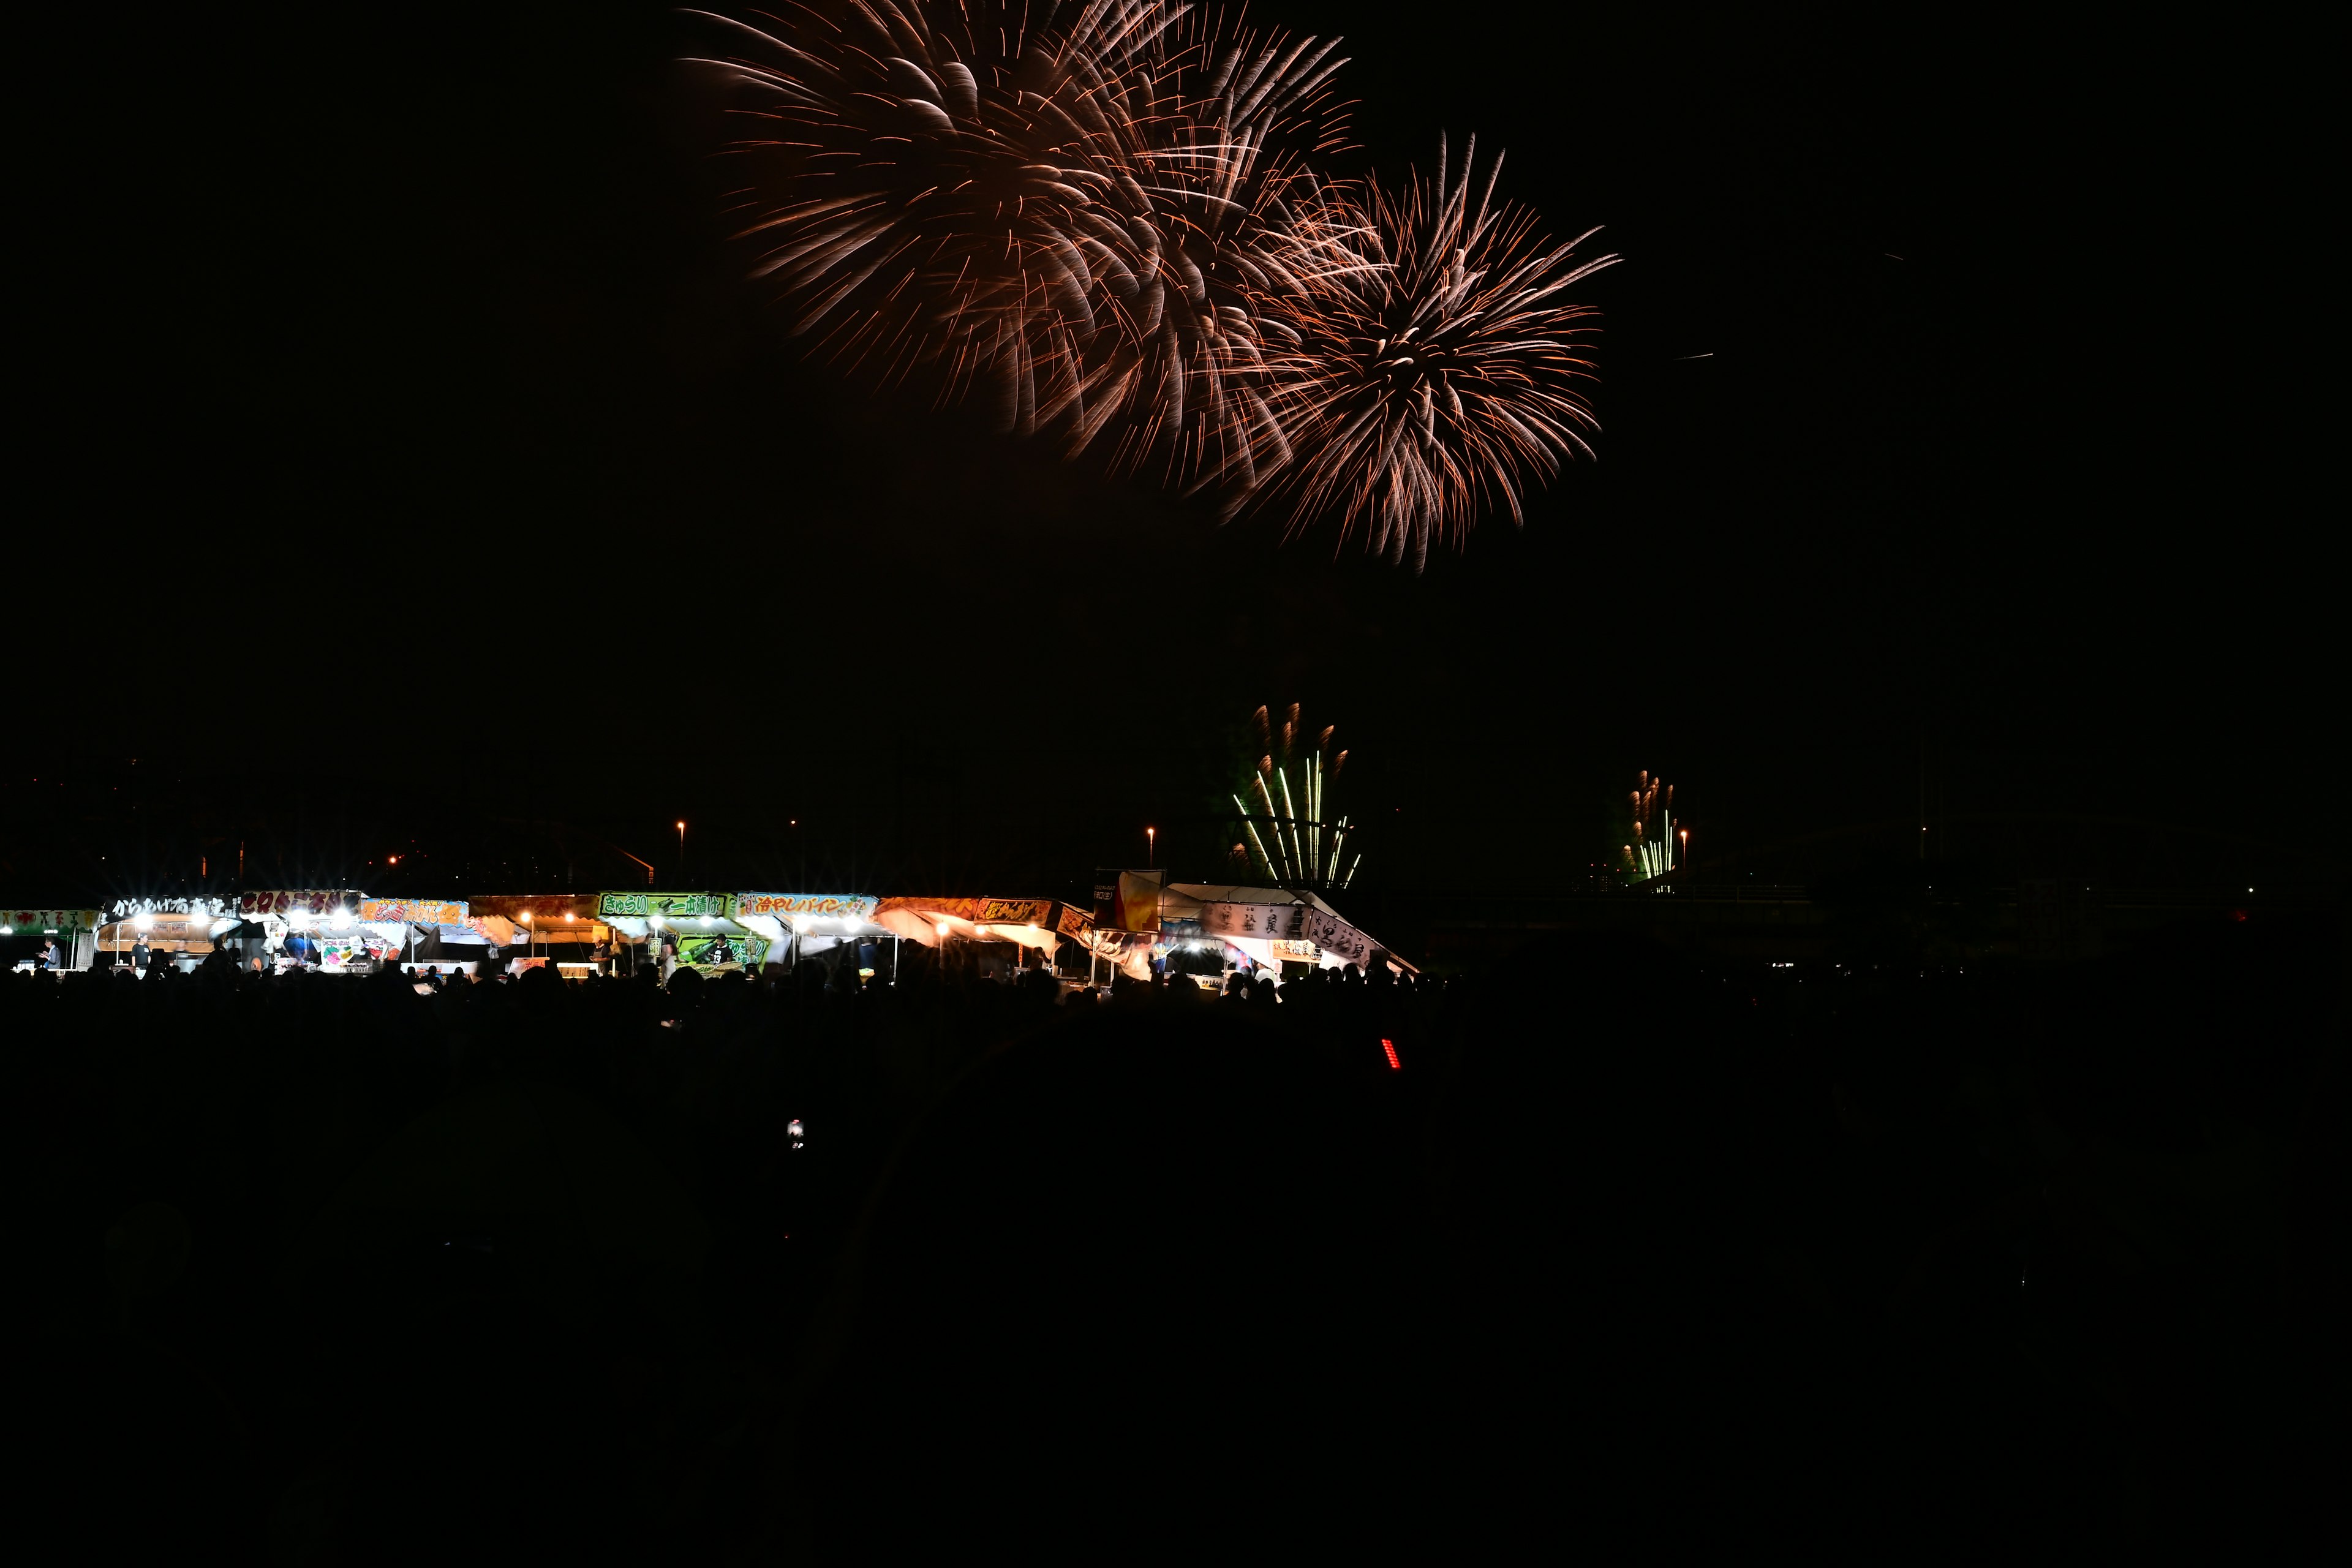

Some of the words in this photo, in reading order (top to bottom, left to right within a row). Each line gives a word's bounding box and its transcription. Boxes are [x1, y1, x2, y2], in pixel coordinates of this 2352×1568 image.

[605, 895, 648, 914] きゅうり
[670, 895, 719, 915] 一本漬け
[755, 896, 844, 913] 冷やしパイン
